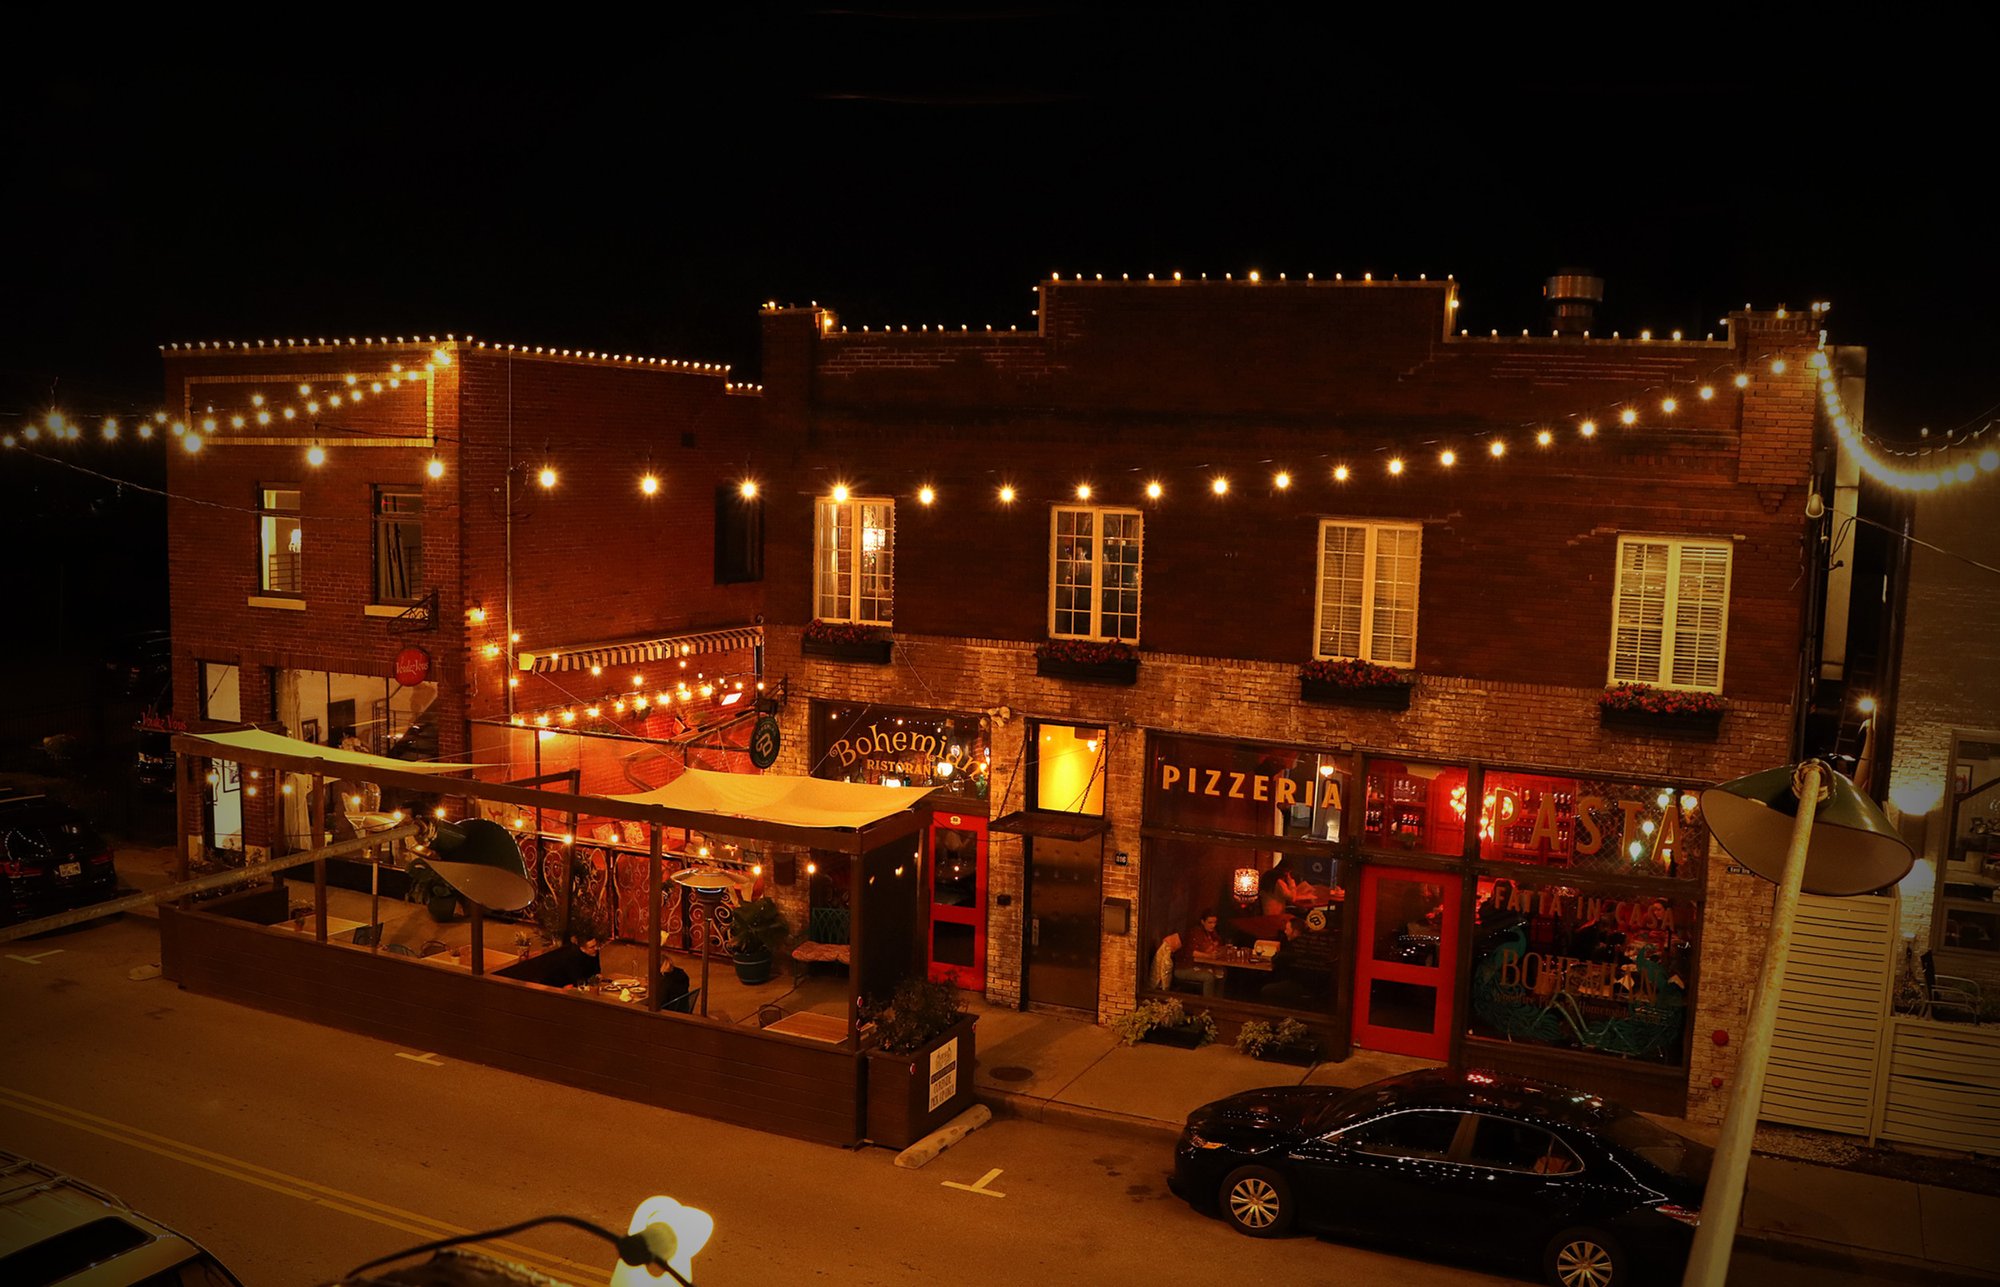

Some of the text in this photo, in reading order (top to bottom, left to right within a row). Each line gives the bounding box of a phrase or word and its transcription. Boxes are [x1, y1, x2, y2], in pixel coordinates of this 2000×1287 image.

[829, 723, 989, 782] Bohemian
[1162, 764, 1342, 811] PIZZERIA
[1492, 787, 1683, 865] PASTA
[1494, 886, 1676, 932] FATTA IN CASA
